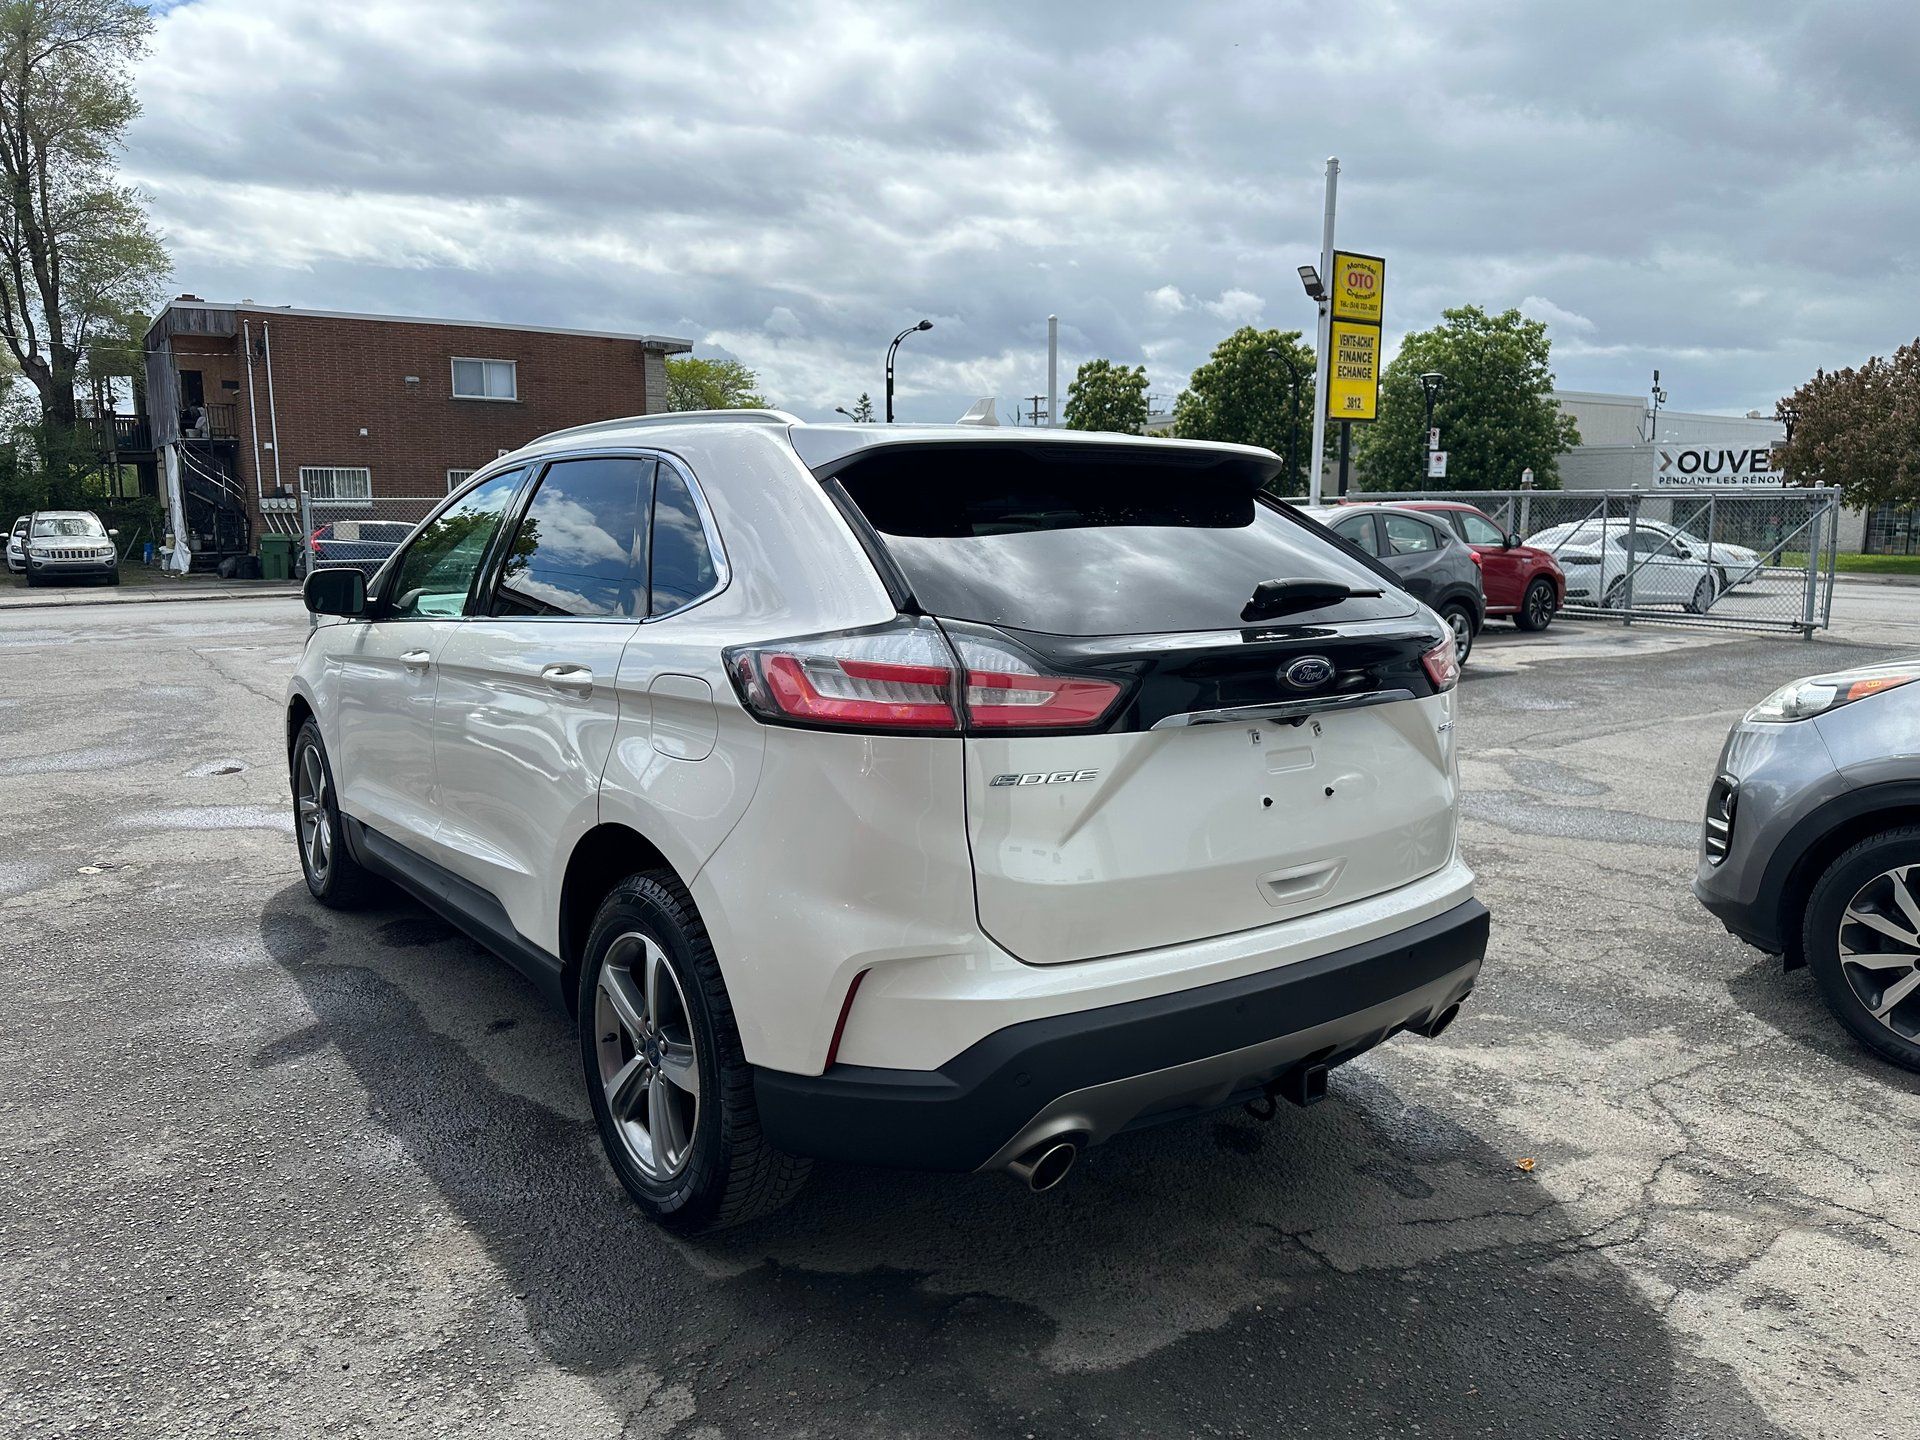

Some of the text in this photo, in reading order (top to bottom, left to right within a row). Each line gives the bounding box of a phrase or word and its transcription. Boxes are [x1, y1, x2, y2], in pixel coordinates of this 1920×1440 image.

[1348, 272, 1374, 289] OTO
[1339, 334, 1375, 349] VENTE-ACHAT
[1338, 349, 1373, 364] FINANCE
[1337, 365, 1372, 379] ECHANGE
[1346, 396, 1362, 409] 3812
[1677, 449, 1779, 474] OUVE
[1659, 476, 1712, 485] PENDANT
[1716, 476, 1738, 485] LES
[1299, 664, 1324, 681] Ford
[989, 767, 1100, 787] EDGE
